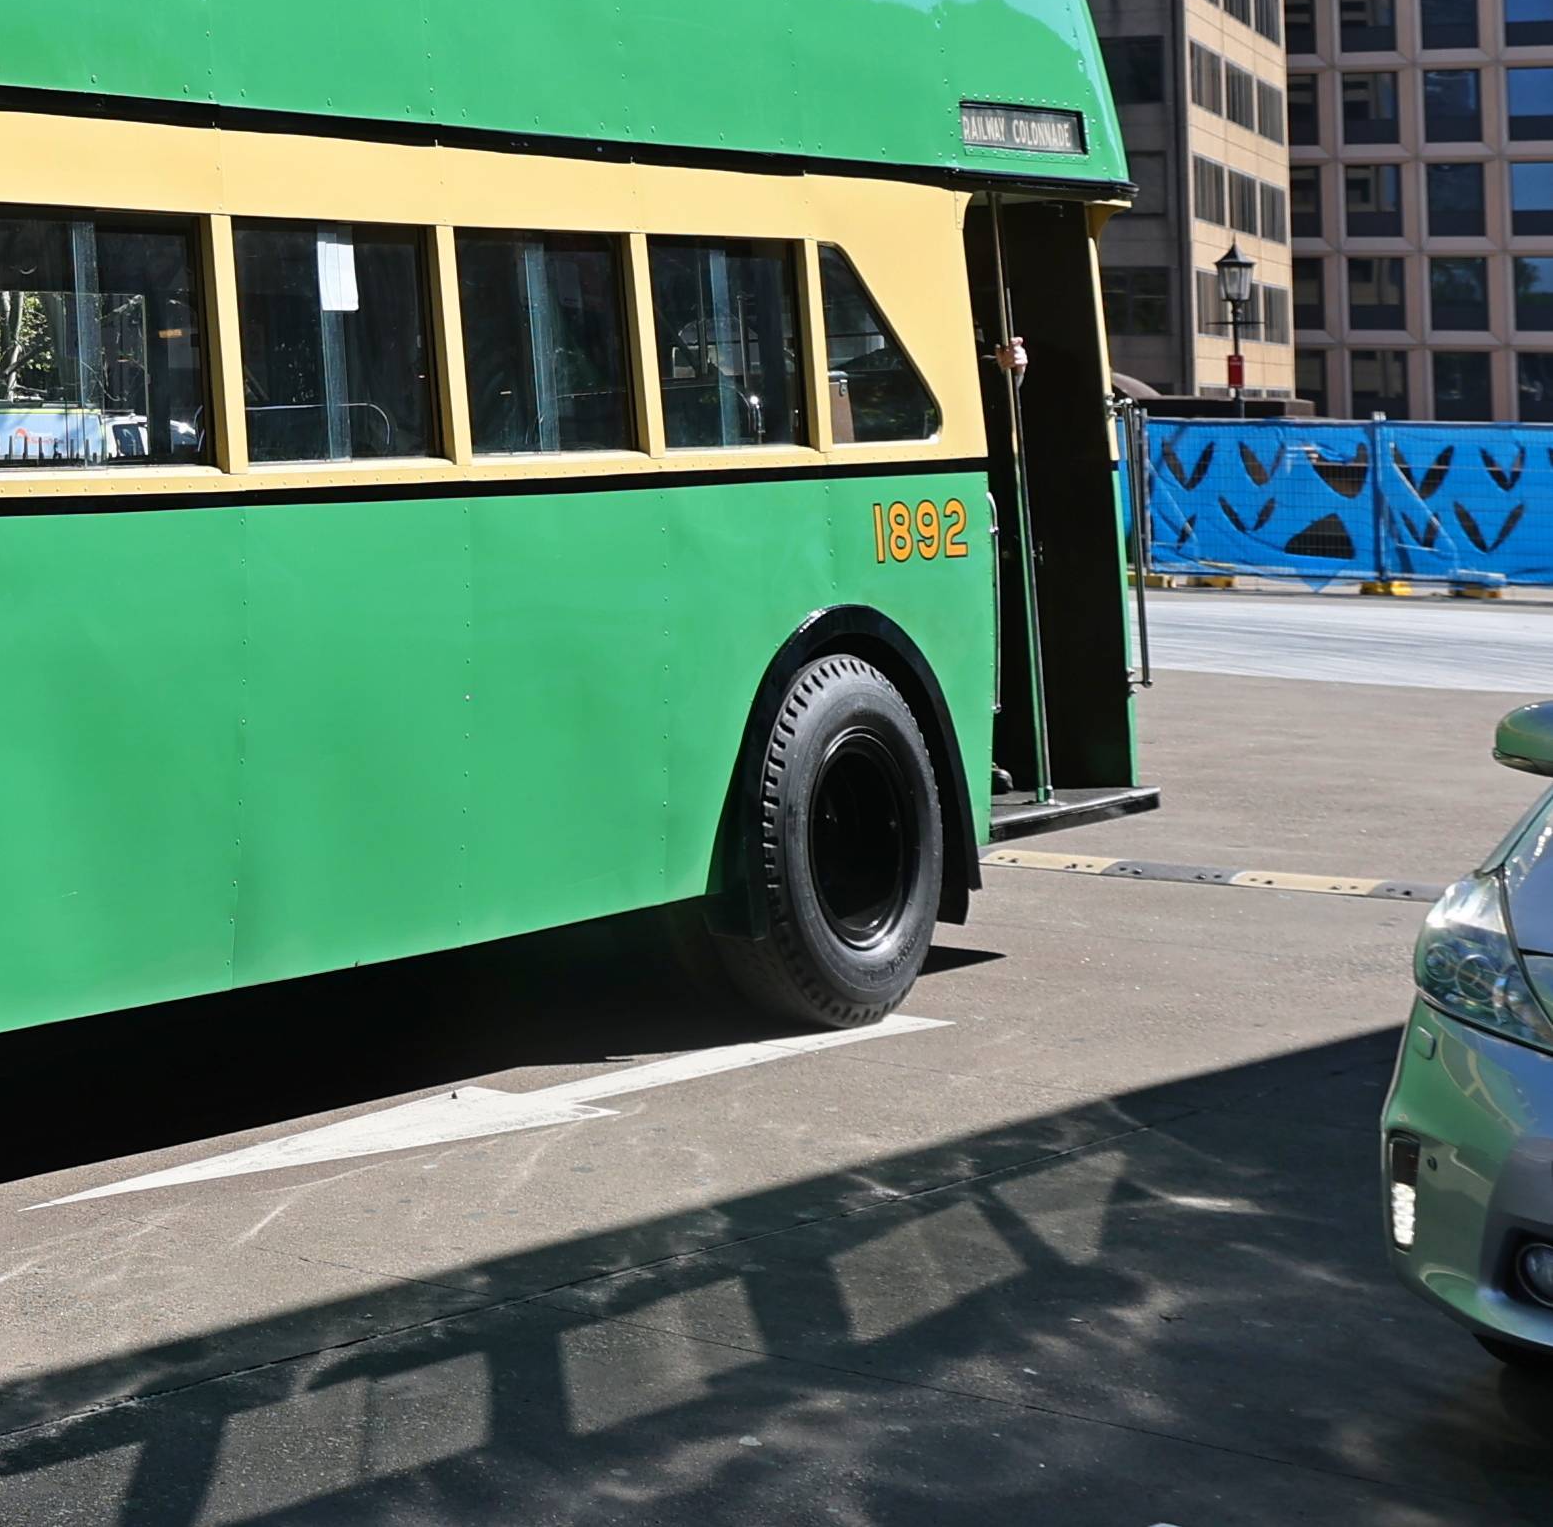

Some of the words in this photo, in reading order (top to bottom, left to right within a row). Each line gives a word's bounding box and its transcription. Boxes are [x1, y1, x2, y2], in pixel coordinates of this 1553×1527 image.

[962, 115, 1005, 142] RAILWAY
[1012, 119, 1071, 147] COLONNADE
[873, 498, 969, 564] 1892
